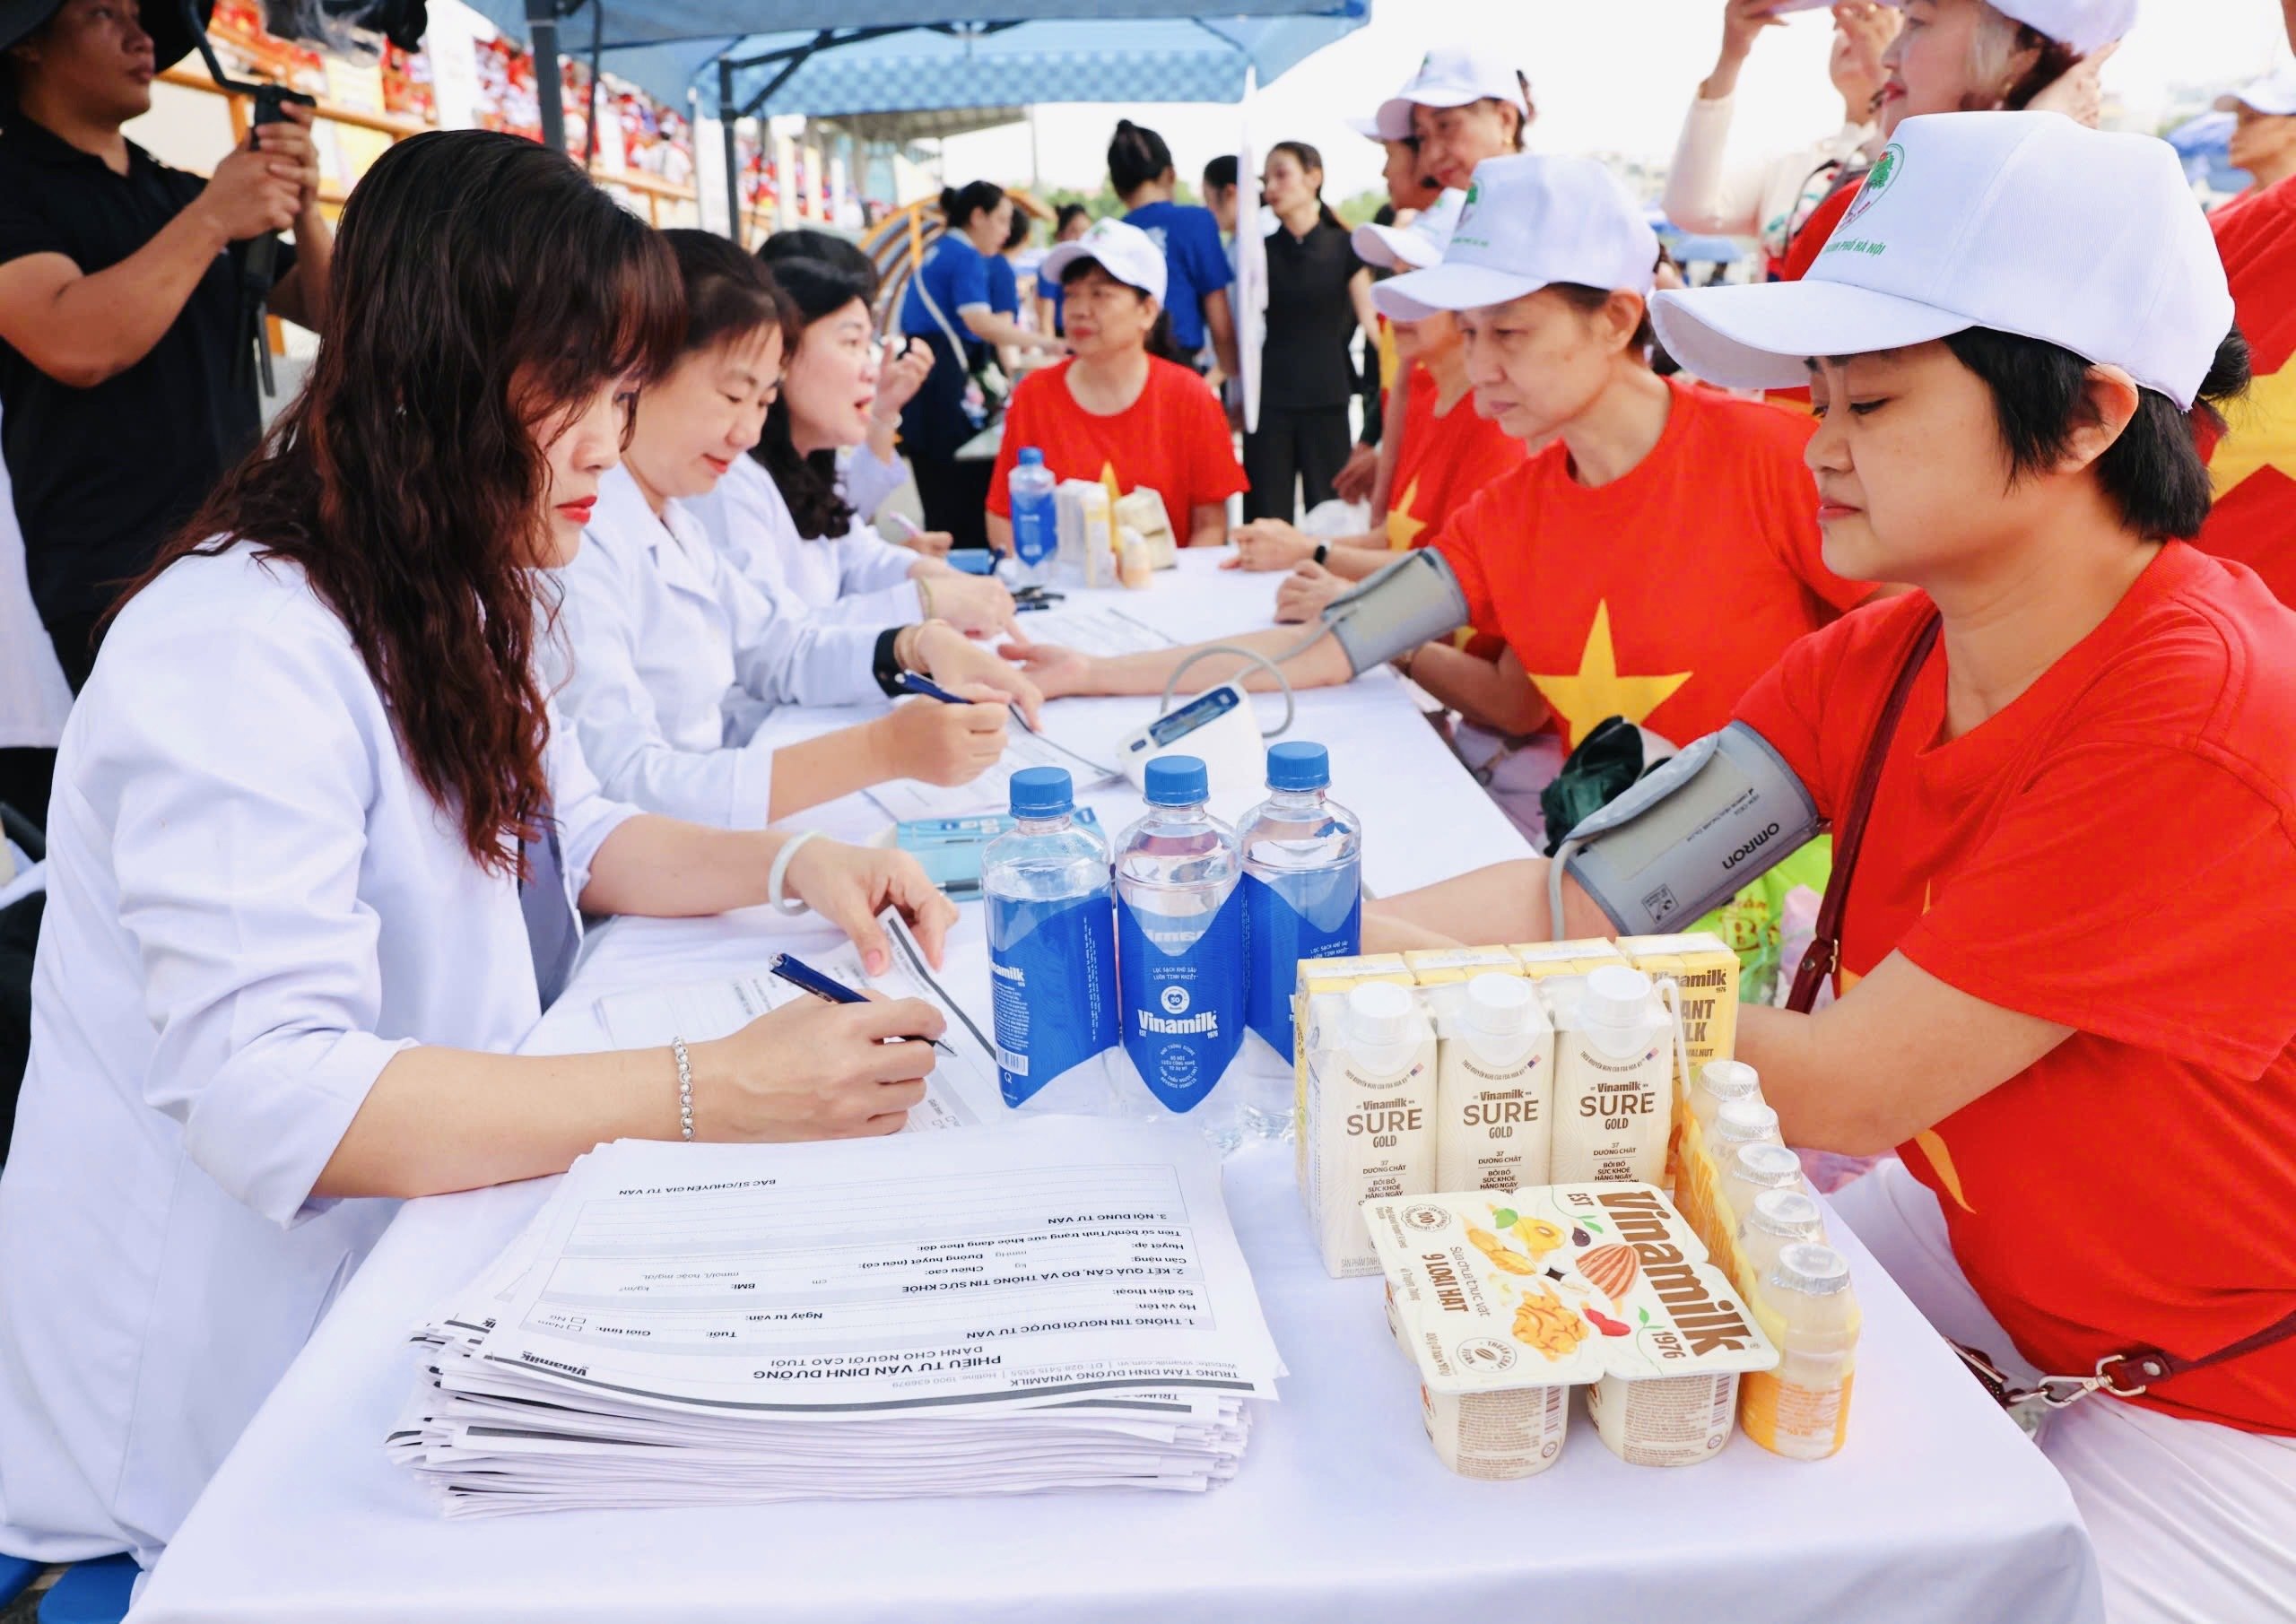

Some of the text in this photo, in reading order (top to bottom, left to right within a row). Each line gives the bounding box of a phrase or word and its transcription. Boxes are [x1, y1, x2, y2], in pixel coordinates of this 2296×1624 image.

[1137, 1009, 1218, 1034] Vinamilk
[1597, 1081, 1640, 1093] Vinamilk
[1480, 1089, 1524, 1101] Vinamilk
[1363, 1098, 1407, 1111] Vinamilk
[1579, 1092, 1655, 1117] SURE
[1463, 1099, 1539, 1126] SURE
[1347, 1107, 1422, 1136] SURE
[1605, 1118, 1629, 1131] GOLD
[1489, 1125, 1513, 1140] GOLD
[1373, 1134, 1396, 1149] GOLD
[665, 1185, 685, 1194] GIA
[1133, 1212, 1153, 1221] NỘI
[1048, 1217, 1074, 1226] VẤN
[1050, 1232, 1080, 1240] trạng
[1157, 1229, 1182, 1238] Tiền
[1131, 1242, 1148, 1250] áp:
[1151, 1243, 1184, 1251] Huyết
[911, 1257, 943, 1265] huyết
[945, 1253, 984, 1263] Đường
[1131, 1255, 1161, 1264] nặng:
[1422, 1253, 1446, 1261] 9
[883, 1260, 908, 1268] (nếu
[1013, 1262, 1027, 1270] kg
[951, 1265, 984, 1274] Chiều
[1117, 1268, 1144, 1276] QUẢ
[1147, 1268, 1170, 1276] KẾT
[1596, 1191, 1752, 1357] Vinamilk
[993, 1275, 1037, 1285] THÔNG
[1041, 1273, 1058, 1282] VÀ
[1567, 1193, 1686, 1359] EST 1976
[939, 1281, 967, 1290] SỨC
[970, 1280, 990, 1288] TIN
[1112, 1288, 1194, 1297] Số điện thoại:
[745, 1315, 771, 1323] vấn:
[791, 1312, 822, 1321] Ngày
[1063, 1319, 1108, 1329] NGƯỜI
[1135, 1317, 1182, 1326] THÔNG
[596, 1326, 650, 1337] Giới tính:
[967, 1331, 995, 1341] VẤN
[999, 1327, 1018, 1336] TƯ
[770, 1346, 983, 1368] DÀNH CHO NGƯỜI CAO TUỔI
[521, 1352, 587, 1376] Vinamilk
[752, 1355, 1001, 1381] PHIẾU TƯ VẤN DINH DƯỠNG
[1010, 1368, 1035, 1376] 5555
[932, 1376, 956, 1385] 1900
[1010, 1368, 1239, 1387] TRUNG TÂM DINH DƯỠNG VINAMILK
